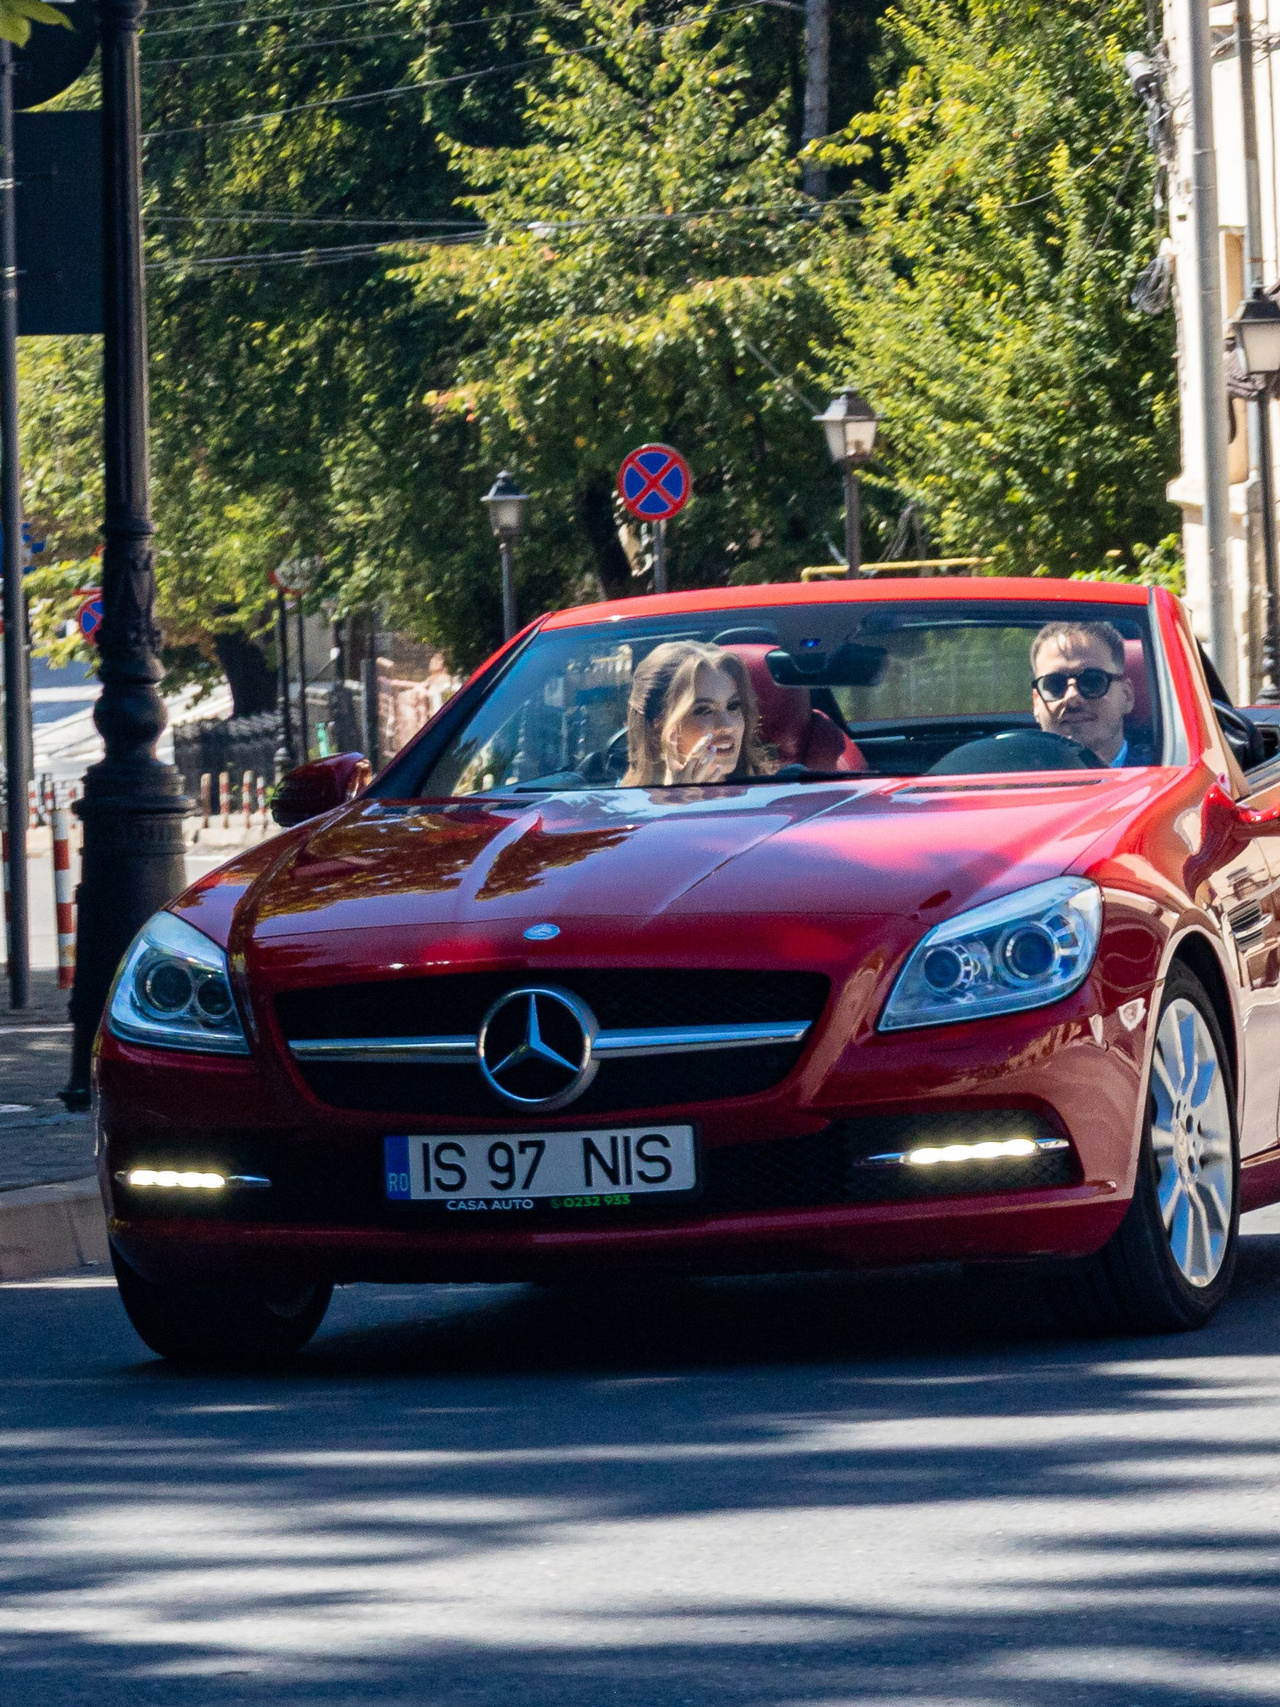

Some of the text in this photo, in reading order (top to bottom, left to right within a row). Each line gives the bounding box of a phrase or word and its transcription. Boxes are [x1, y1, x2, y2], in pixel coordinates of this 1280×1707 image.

[388, 1133, 673, 1193] RO IS 97 NIS
[446, 1199, 534, 1211] CASA AUTO
[563, 1194, 631, 1208] 0232 933
